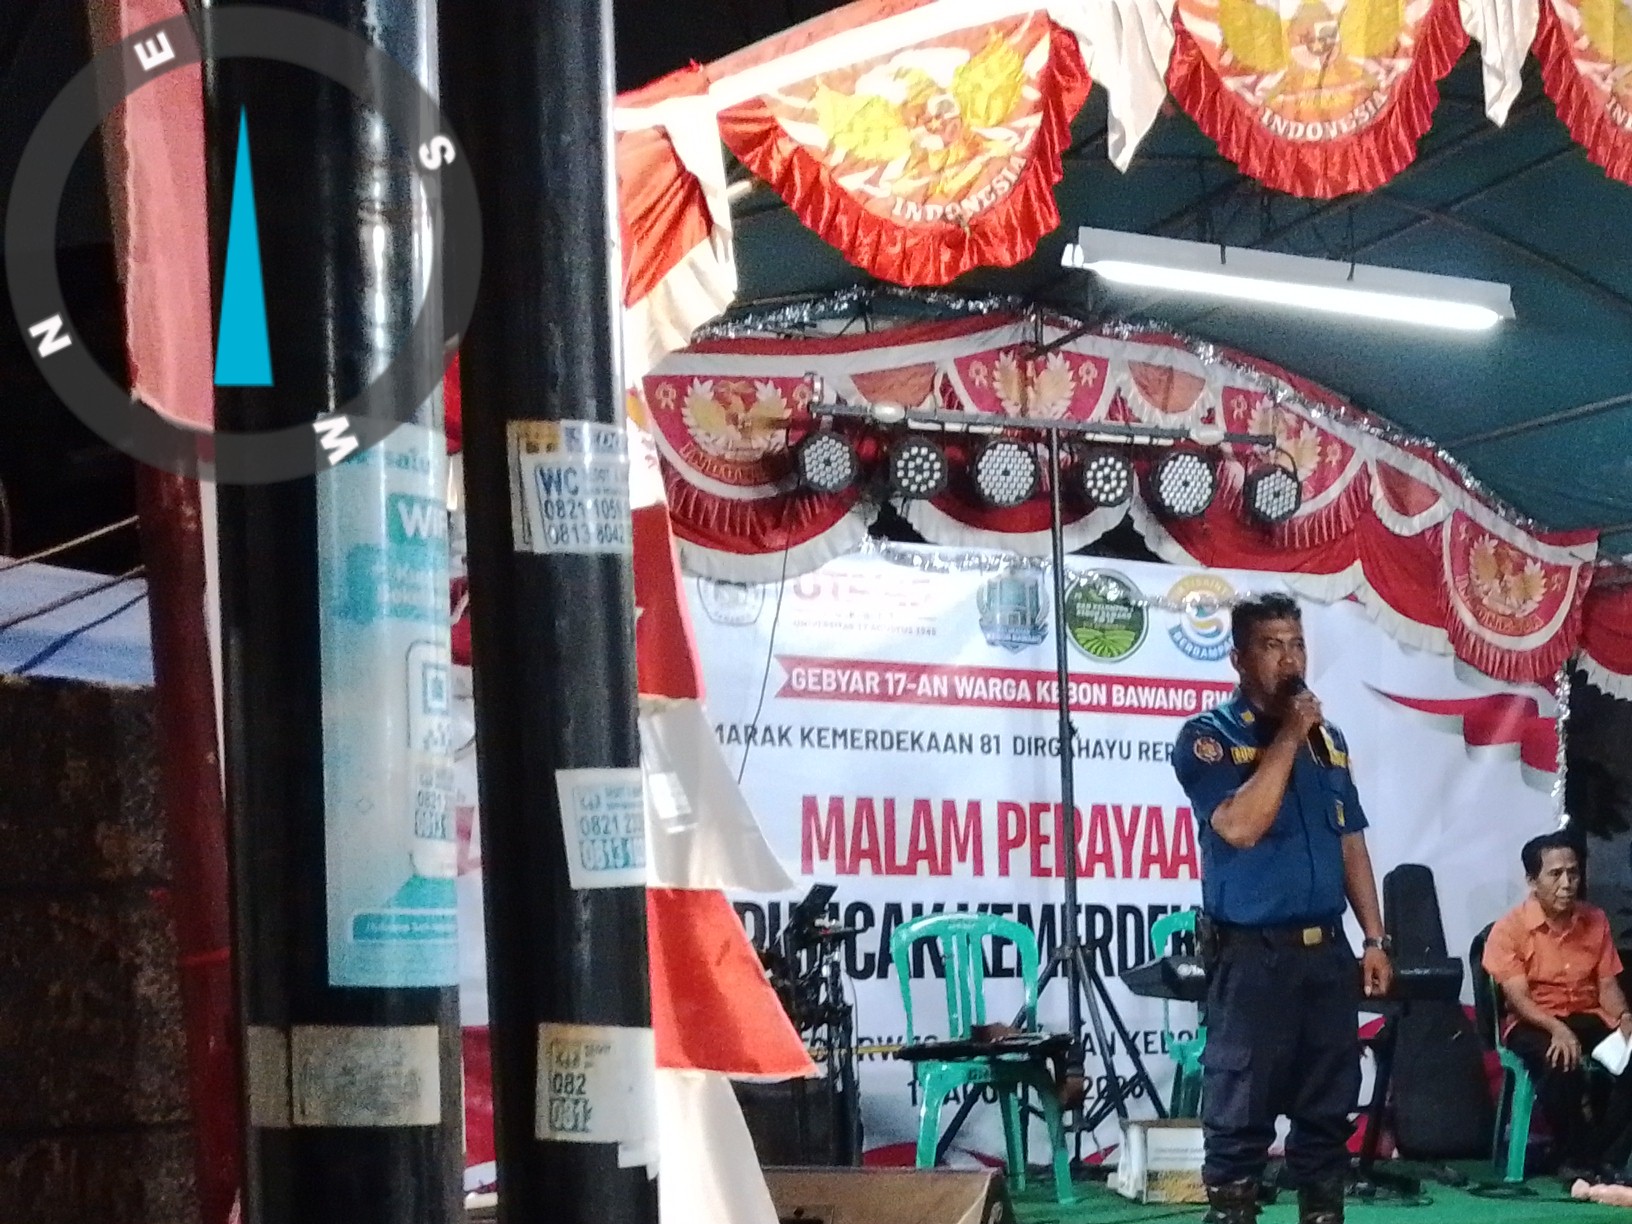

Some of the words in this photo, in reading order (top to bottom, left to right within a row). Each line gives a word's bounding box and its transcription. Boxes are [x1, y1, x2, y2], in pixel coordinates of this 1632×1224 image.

[1262, 91, 1387, 141] INDONESIA
[892, 155, 1027, 222] INDONESIA
[539, 466, 579, 496] WC
[790, 667, 880, 695] GEBYAR
[885, 671, 949, 698] 17-AN
[954, 675, 1031, 702] WARGA
[1111, 683, 1197, 711] BAWANG
[800, 726, 974, 755] KEMERDEKAAN
[980, 733, 1000, 755] 81
[1013, 735, 1132, 761] DIRGHAYU
[801, 796, 984, 877] MALAM
